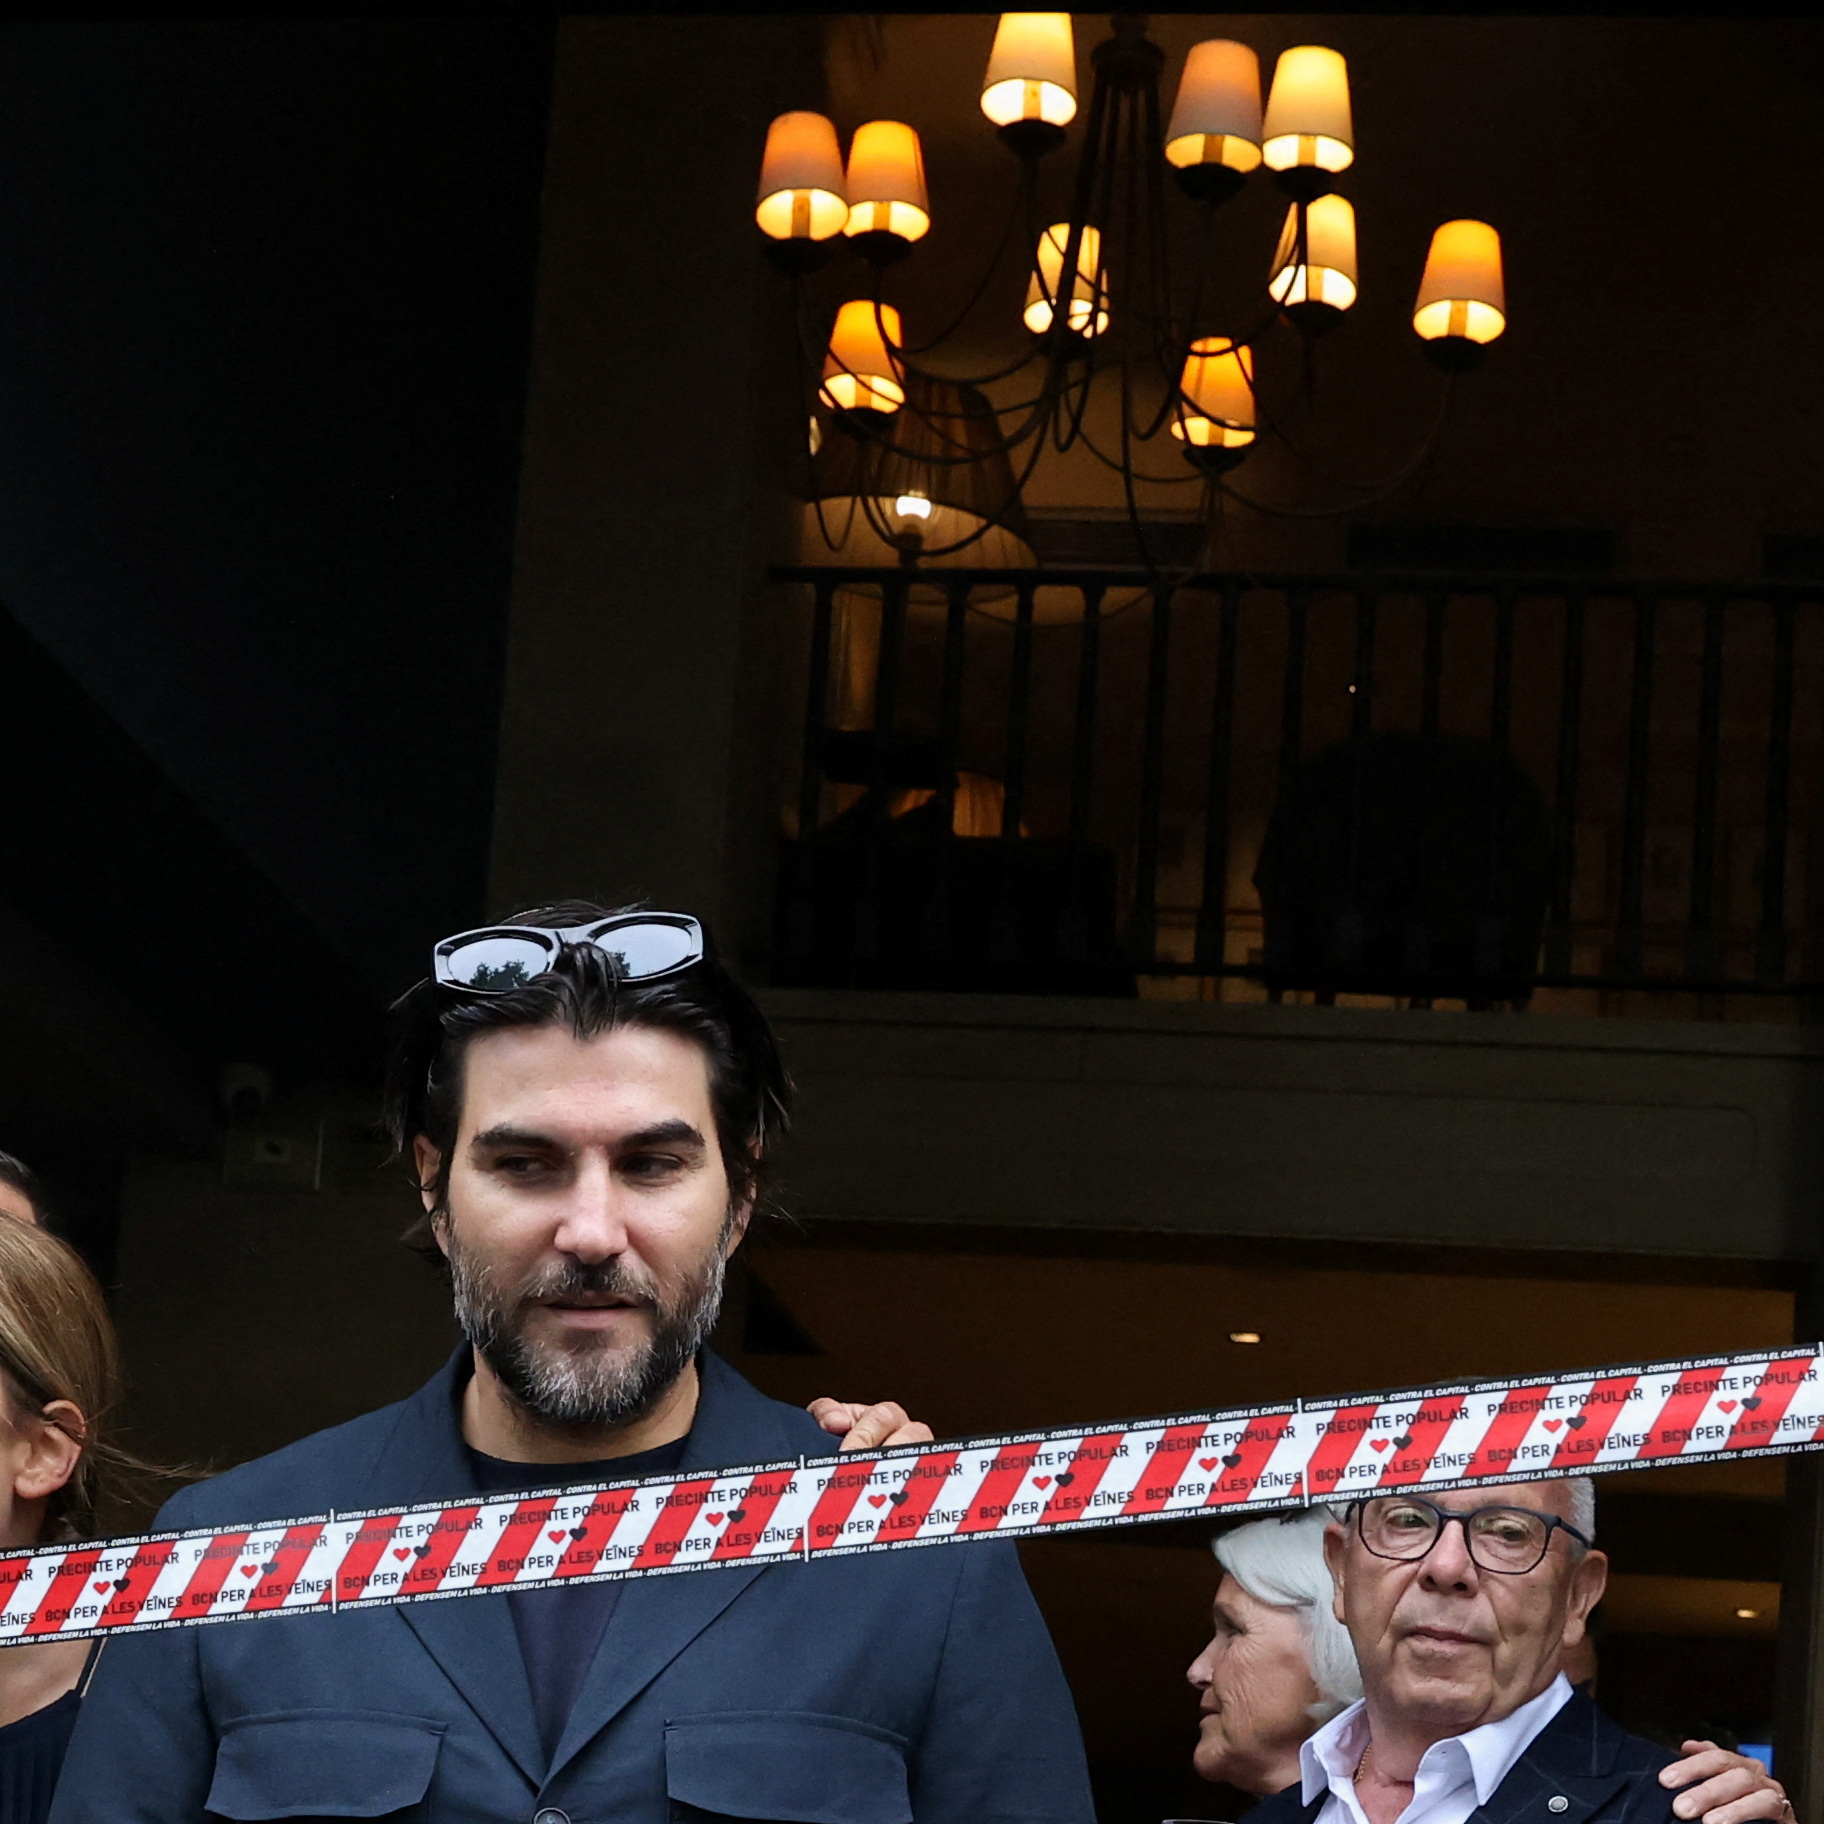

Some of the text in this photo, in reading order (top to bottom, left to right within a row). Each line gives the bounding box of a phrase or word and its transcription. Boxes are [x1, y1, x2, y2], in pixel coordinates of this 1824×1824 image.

[1733, 1352, 1767, 1364] CONTRA
[1780, 1347, 1815, 1359] CAPITAL
[1474, 1380, 1508, 1392] CONTRA
[1521, 1375, 1556, 1387] CAPITAL
[1660, 1367, 1817, 1398] PRECINTE POPULAR
[1215, 1409, 1247, 1421] CONTRA
[1260, 1403, 1294, 1416] CAPITAL
[1487, 1386, 1643, 1417] PRECINTE POPULAR
[1315, 1405, 1469, 1436] PRECINTE POPULAR
[1661, 1427, 1692, 1444] BCN
[1695, 1423, 1723, 1441] PER
[1727, 1423, 1737, 1437] A
[1741, 1418, 1769, 1435] LES
[968, 1437, 1000, 1449] CONTRA
[1012, 1432, 1046, 1444] CAPITAL
[1145, 1424, 1295, 1455] PRECINTE POPULAR
[1487, 1428, 1650, 1463] BCN PER A LES VEÏNES
[1741, 1445, 1789, 1459] DEFENSEM
[979, 1443, 1128, 1474] PRECINTE POPULAR
[1315, 1447, 1476, 1482] BCN PER A LES VEÏNES
[655, 1480, 797, 1510] PRECINTE POPULAR
[1145, 1467, 1302, 1501] BCN PER A LES VEÏNES
[1396, 1481, 1443, 1495] DEFENSEM
[499, 1498, 639, 1527] PRECINTE POPULAR
[979, 1485, 1134, 1519] BCN PER A LES VEÏNES
[654, 1522, 803, 1555] BCN PER A LES VEÏNES
[973, 1527, 1018, 1540] DEFENSEM
[497, 1540, 644, 1573] BCN PER A LES VEÏNES
